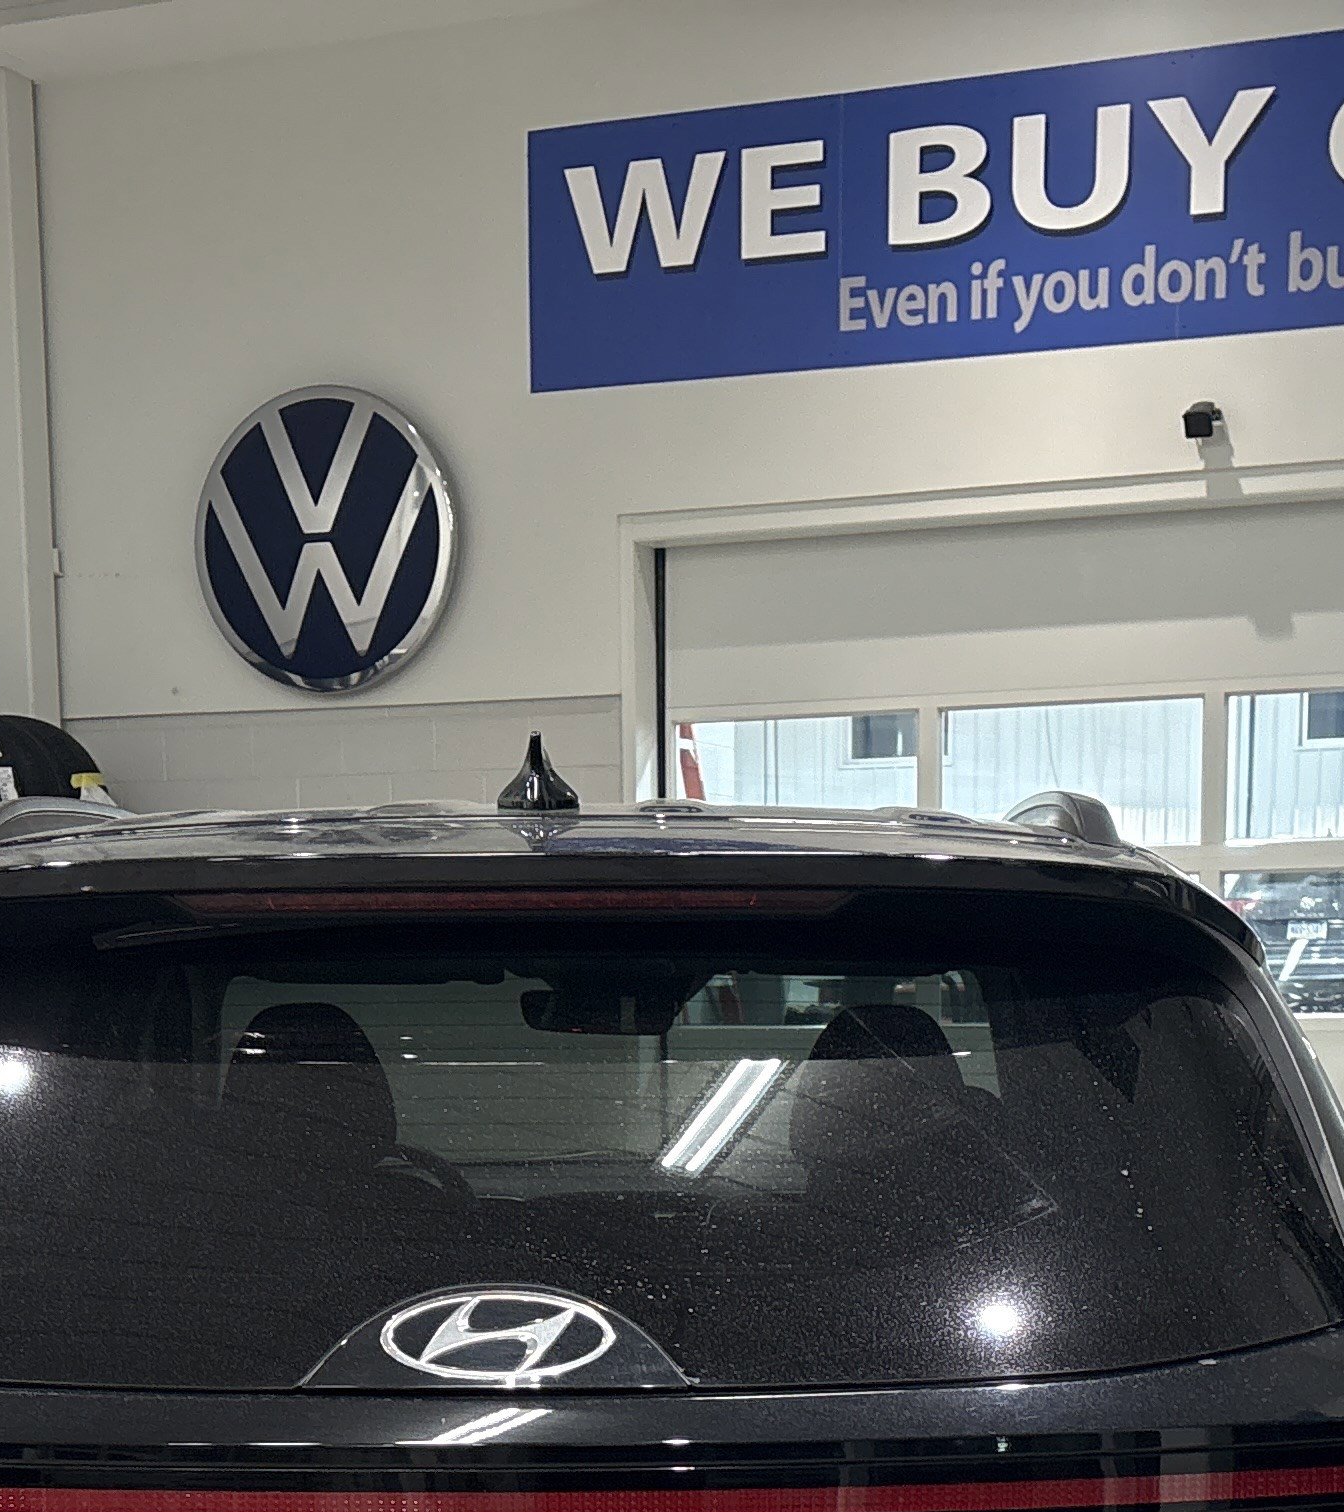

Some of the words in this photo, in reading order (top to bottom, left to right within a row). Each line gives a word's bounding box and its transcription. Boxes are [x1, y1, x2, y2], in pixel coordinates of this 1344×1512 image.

[563, 139, 830, 275] WE
[887, 85, 1278, 247] BUY
[839, 275, 958, 332] Even
[969, 258, 1007, 320] if
[1012, 266, 1110, 334] you
[1120, 238, 1267, 307] don't
